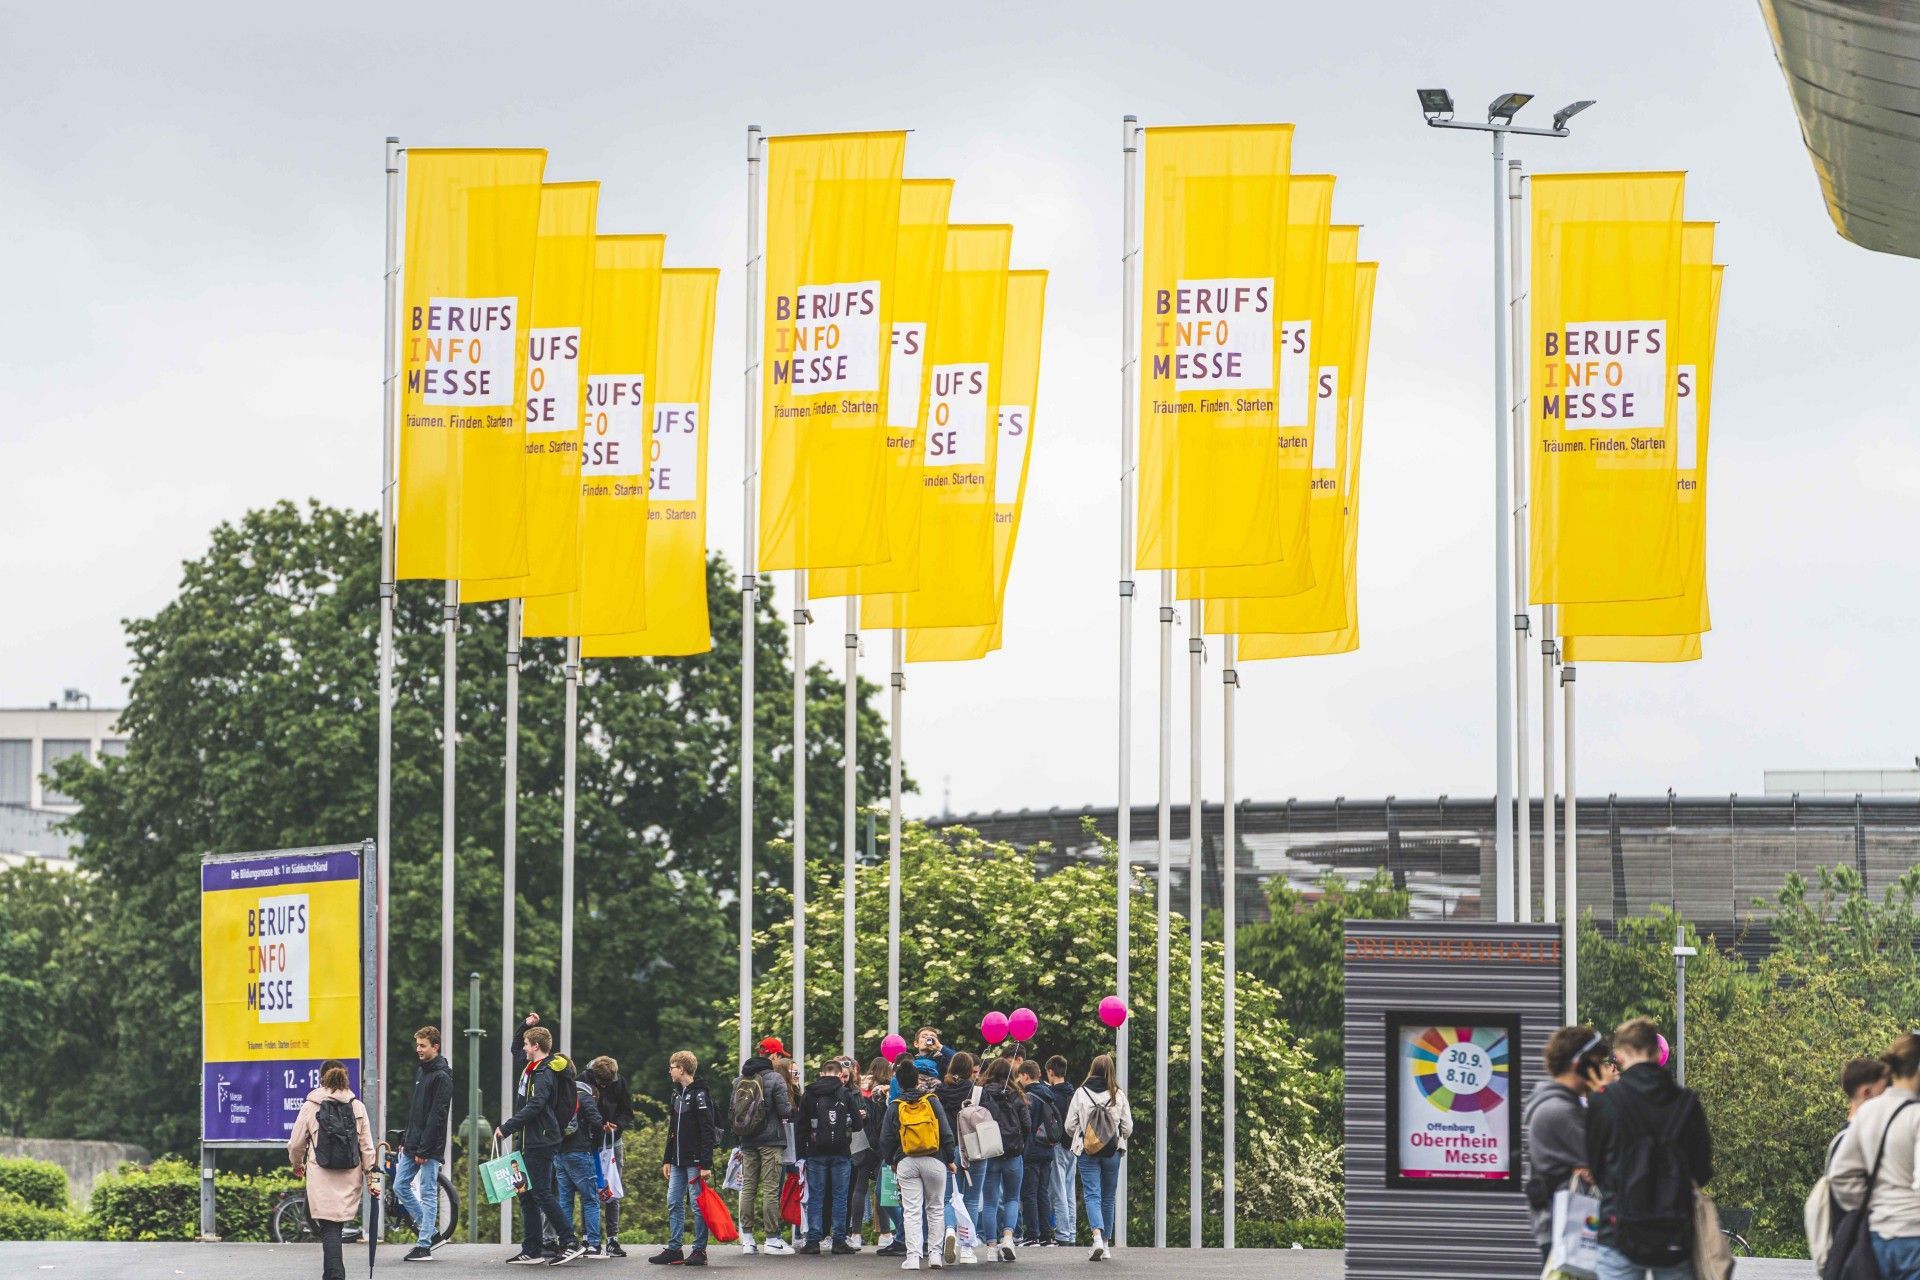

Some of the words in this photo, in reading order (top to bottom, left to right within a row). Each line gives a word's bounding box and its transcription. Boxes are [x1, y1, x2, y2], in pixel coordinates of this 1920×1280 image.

[776, 289, 874, 321] BERUFS
[1156, 286, 1268, 315] BERUFS
[411, 305, 512, 332] BERUFS
[775, 323, 840, 353] INFO
[1155, 319, 1229, 348] INFO
[1545, 328, 1661, 357] BERUFS
[410, 337, 482, 365] INFO
[529, 335, 578, 362] UFS
[773, 355, 848, 385] MESSE
[1153, 352, 1242, 380] MESSE
[1544, 361, 1624, 389] INFO
[407, 369, 491, 396] MESSE
[935, 370, 983, 397] UFS
[841, 400, 879, 414] Starten
[1153, 400, 1197, 414] Träumen.
[1200, 399, 1233, 413] Finden.
[1236, 398, 1274, 412] Starten
[1543, 392, 1635, 420] MESSE
[449, 414, 485, 429] Finden.
[486, 414, 513, 428] Starten
[549, 440, 578, 453] Starten
[886, 435, 915, 449] tarten
[1278, 436, 1308, 449] tarten
[1543, 439, 1587, 453] Träumen.
[1589, 437, 1628, 451] Finden.
[1630, 437, 1666, 450] Starten
[952, 472, 985, 485] Starten
[1311, 477, 1336, 490] arten
[582, 484, 611, 496] Finden.
[614, 483, 643, 496] Starten
[665, 508, 697, 521] Starten
[231, 869, 240, 880] Die
[240, 868, 273, 881] Bildungsmesse
[286, 864, 291, 874] in
[291, 860, 328, 874] Süddeutschland
[247, 903, 306, 938] BERUFS
[247, 942, 286, 974] INFO
[247, 980, 293, 1011] MESSE
[1448, 1049, 1482, 1068] 30.9.
[283, 1069, 298, 1089] 12.
[1446, 1068, 1479, 1087] 8.10.
[1426, 1122, 1476, 1134] Offenburg
[1410, 1131, 1498, 1148] Oberrhein
[1445, 1149, 1498, 1164] Messe
